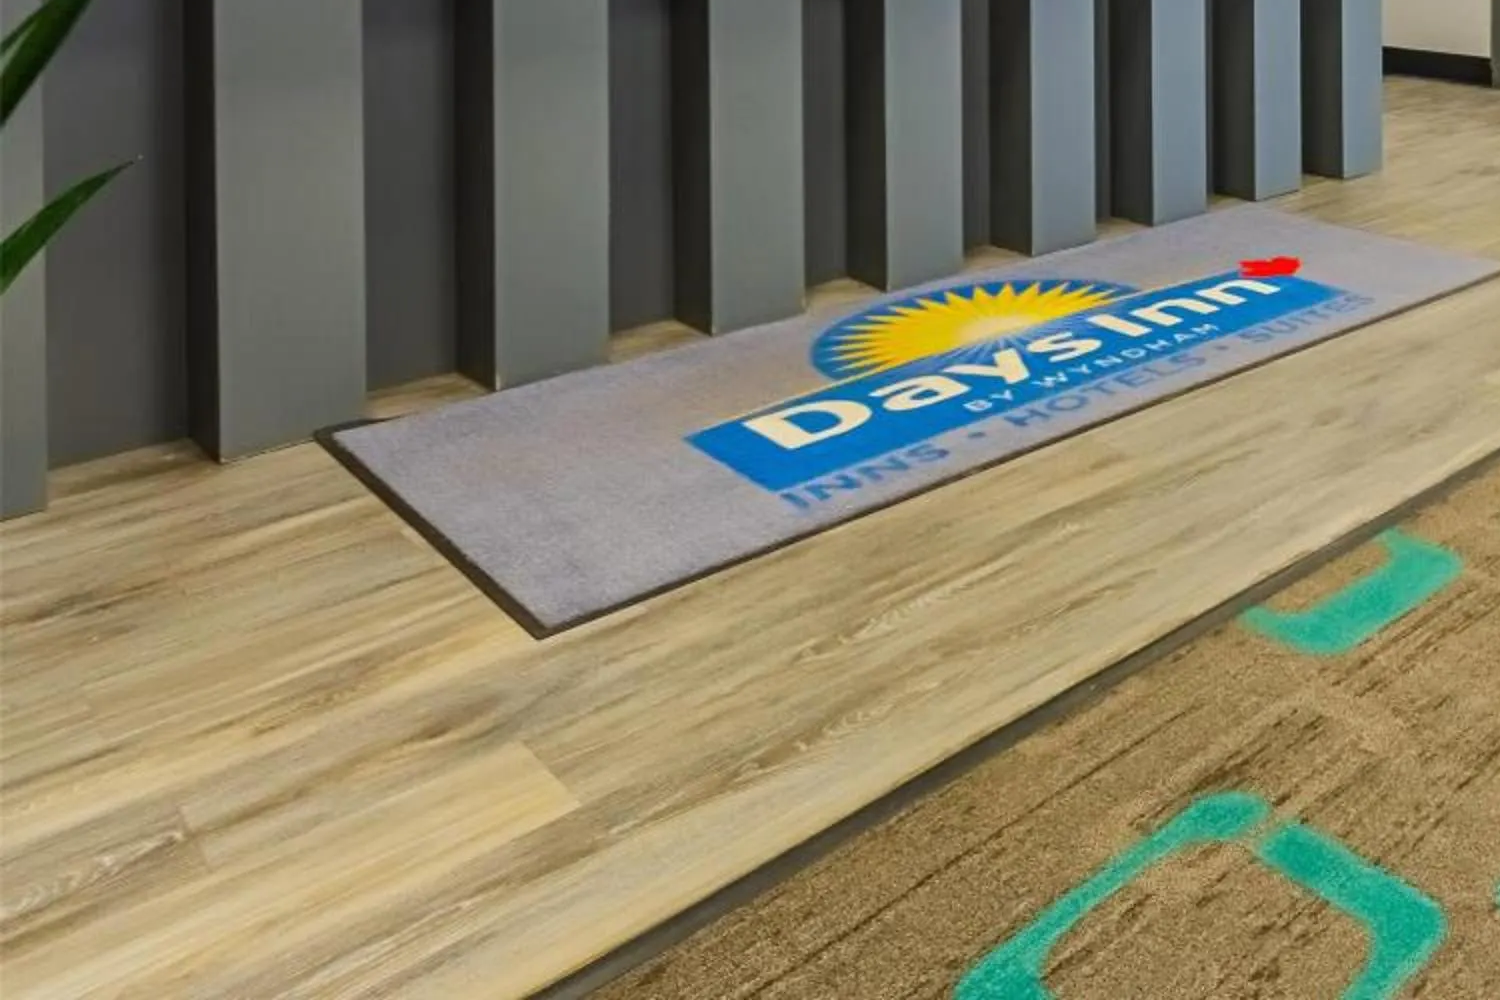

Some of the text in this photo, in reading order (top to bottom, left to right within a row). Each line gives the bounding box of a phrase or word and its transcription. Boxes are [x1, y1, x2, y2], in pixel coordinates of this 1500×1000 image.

[741, 278, 1282, 450] Days Inn
[778, 294, 1377, 509] INNS HOTELS SUITES
[962, 322, 1221, 413] BY WYNDHAM
